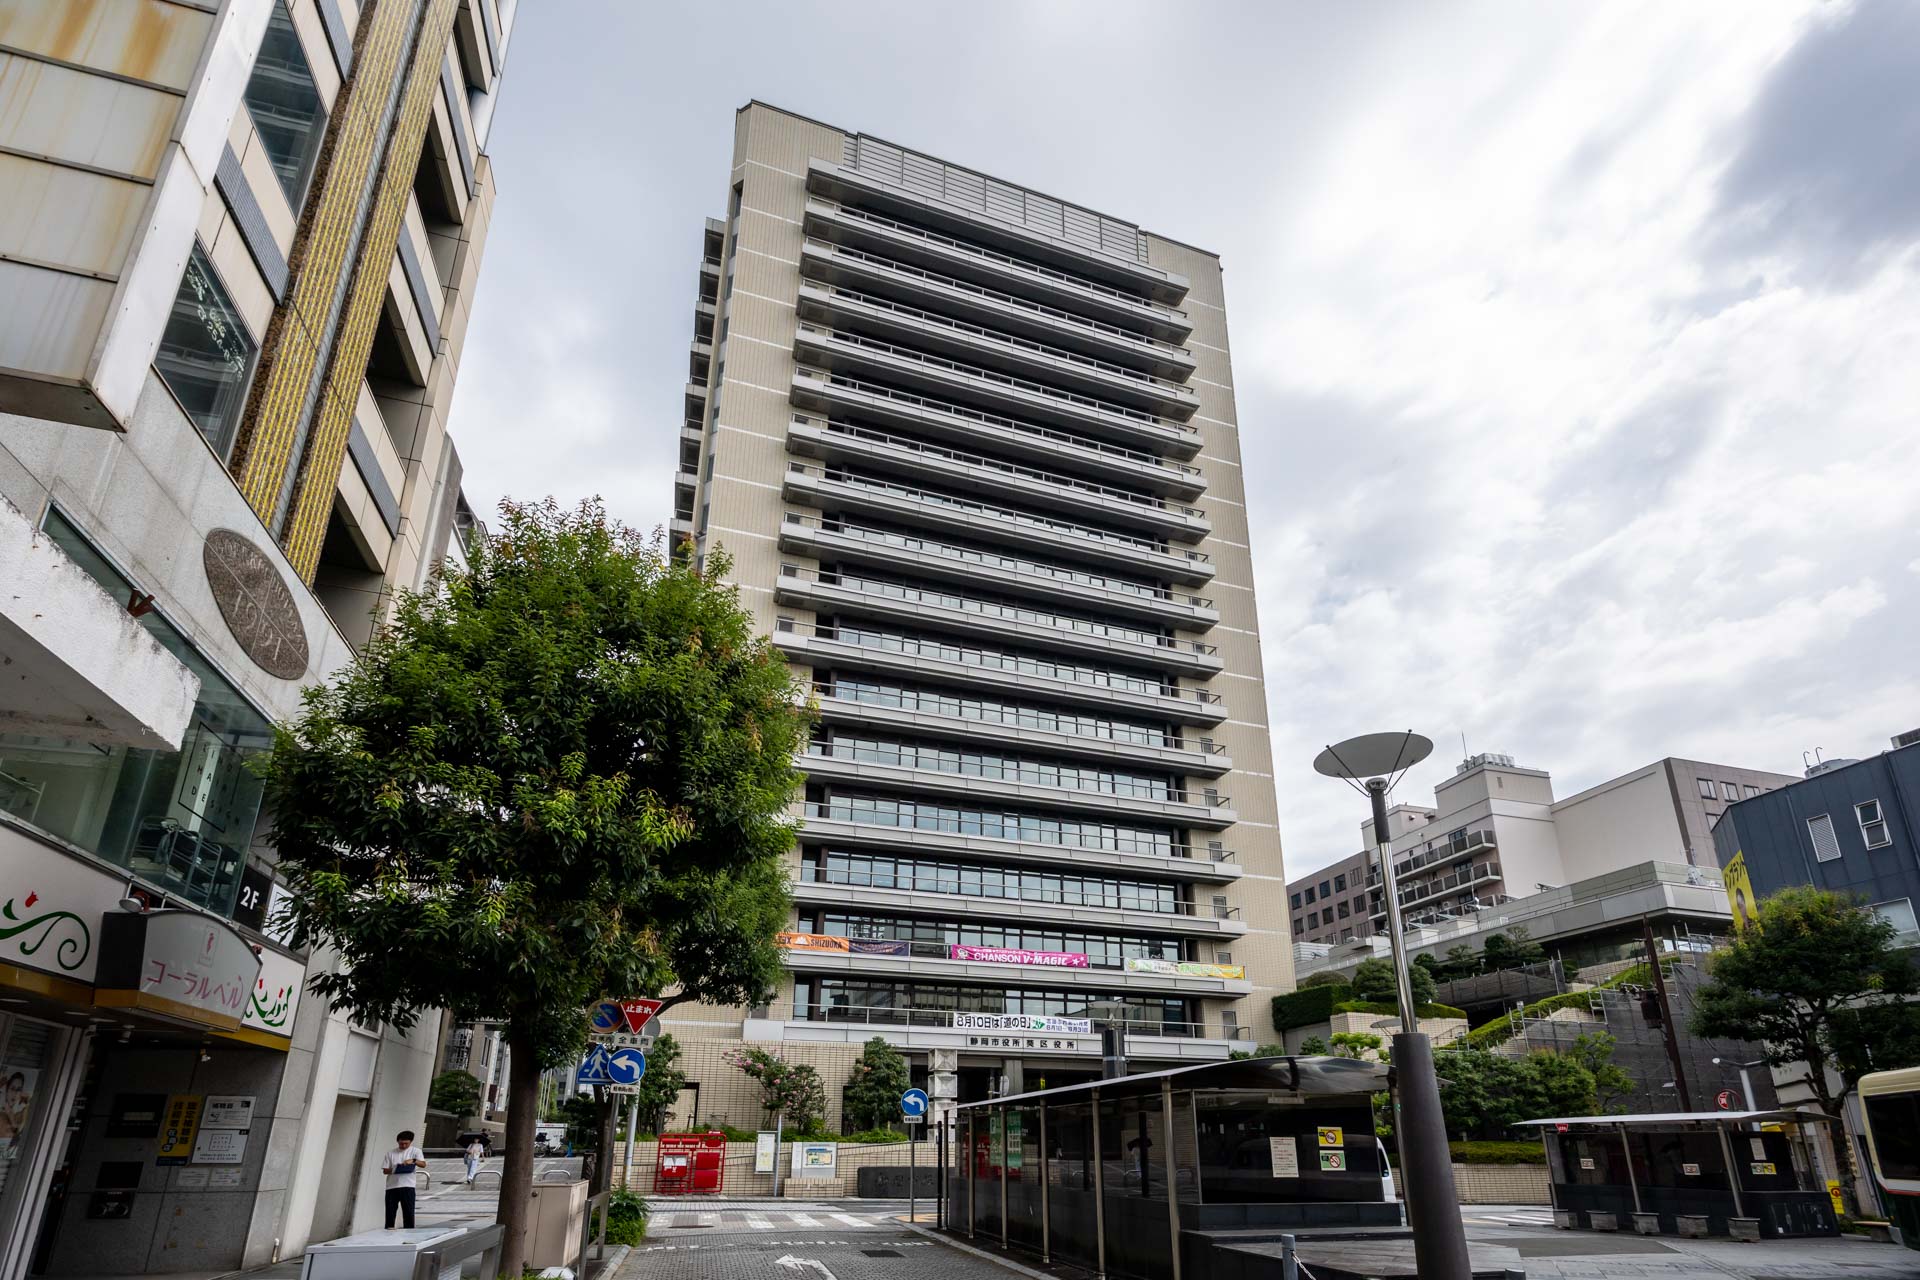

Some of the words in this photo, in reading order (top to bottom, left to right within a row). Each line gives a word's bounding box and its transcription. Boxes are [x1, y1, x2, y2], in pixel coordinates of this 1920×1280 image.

[240, 886, 260, 911] 2F
[810, 938, 842, 949] SHIZUOKA
[973, 952, 1021, 964] CHANSON
[625, 1004, 653, 1014] 止まれ
[956, 1015, 1031, 1029] 8月10日は「道の日」
[618, 1035, 649, 1046] 全車両
